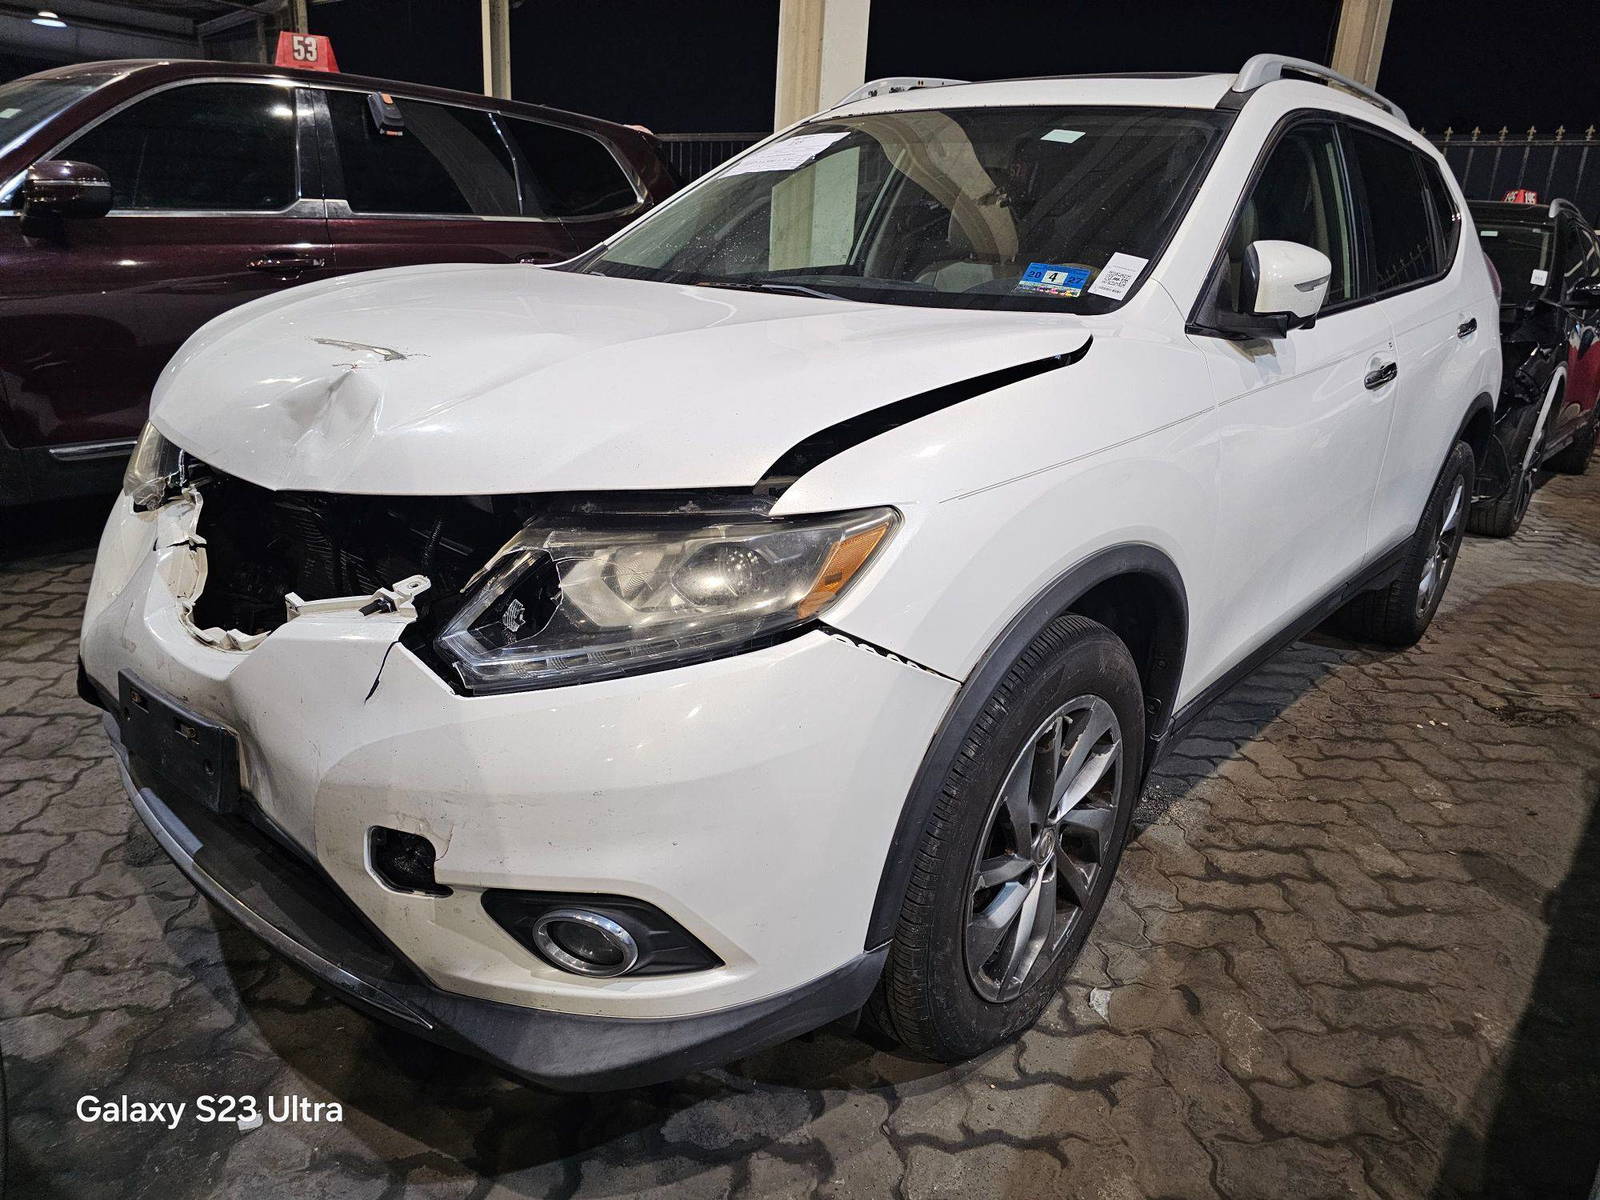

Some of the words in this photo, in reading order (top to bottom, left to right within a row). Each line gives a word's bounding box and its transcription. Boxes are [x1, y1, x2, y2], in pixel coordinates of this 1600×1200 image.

[292, 35, 318, 62] 53
[1029, 270, 1042, 279] 20
[1048, 272, 1059, 282] 4
